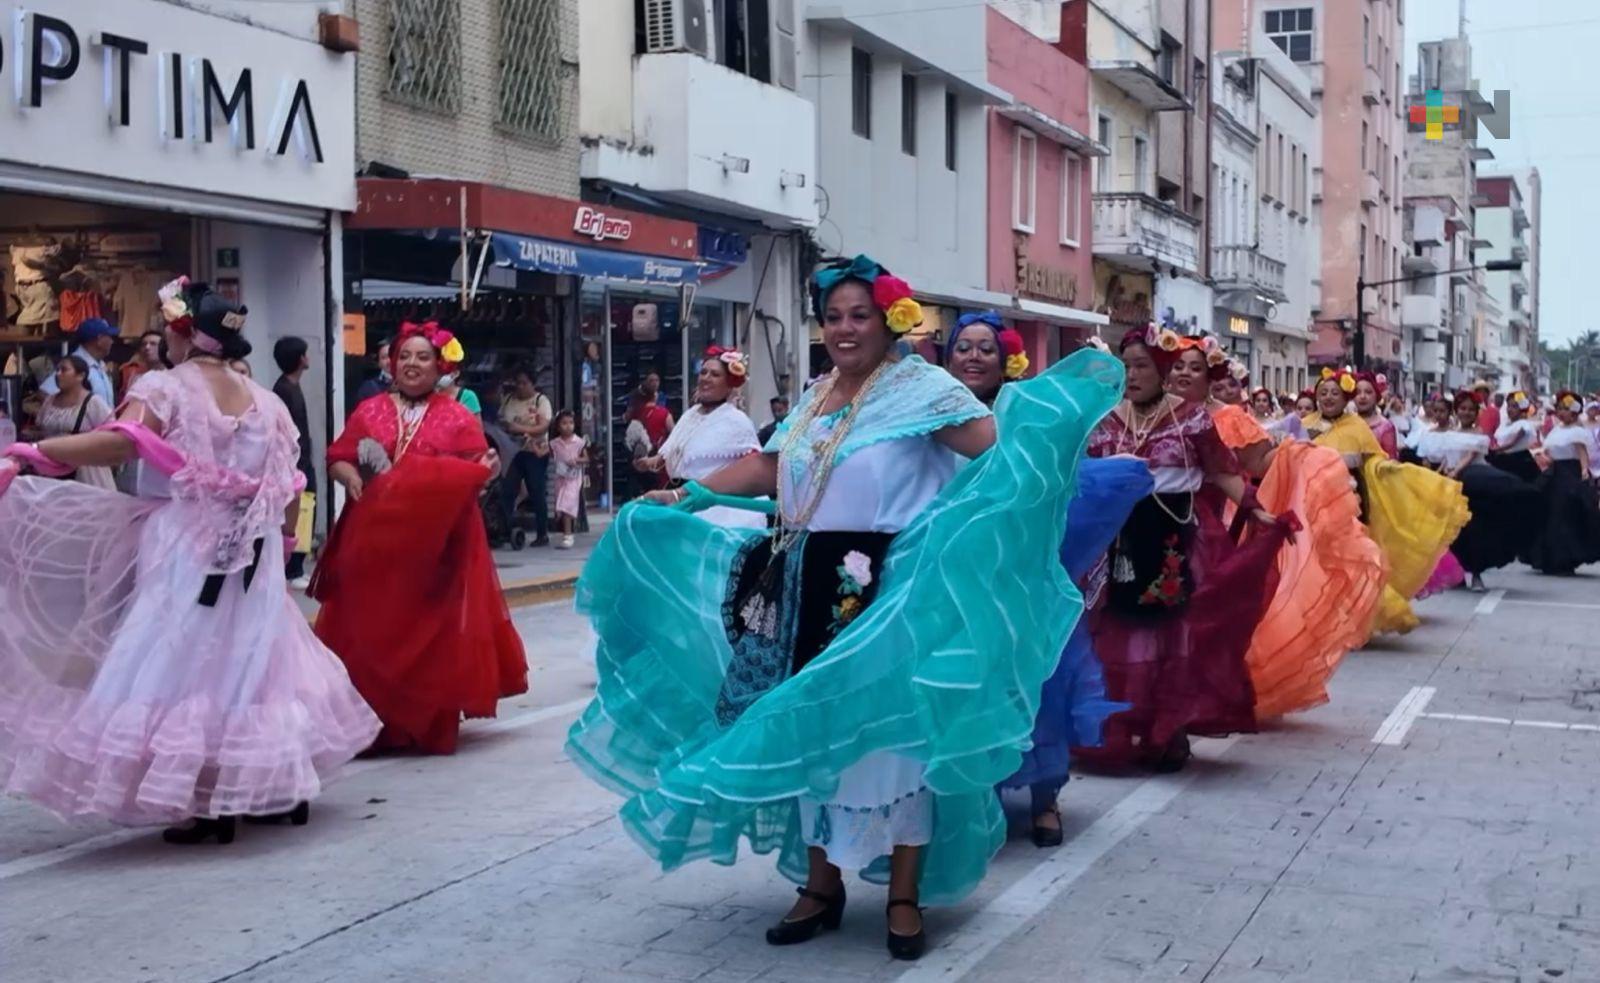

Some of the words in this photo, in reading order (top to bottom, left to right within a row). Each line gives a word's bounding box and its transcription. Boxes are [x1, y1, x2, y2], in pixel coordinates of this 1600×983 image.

[0, 12, 323, 163] PTIMA
[575, 207, 631, 241] Brijama
[518, 241, 578, 267] ZAPATERIA
